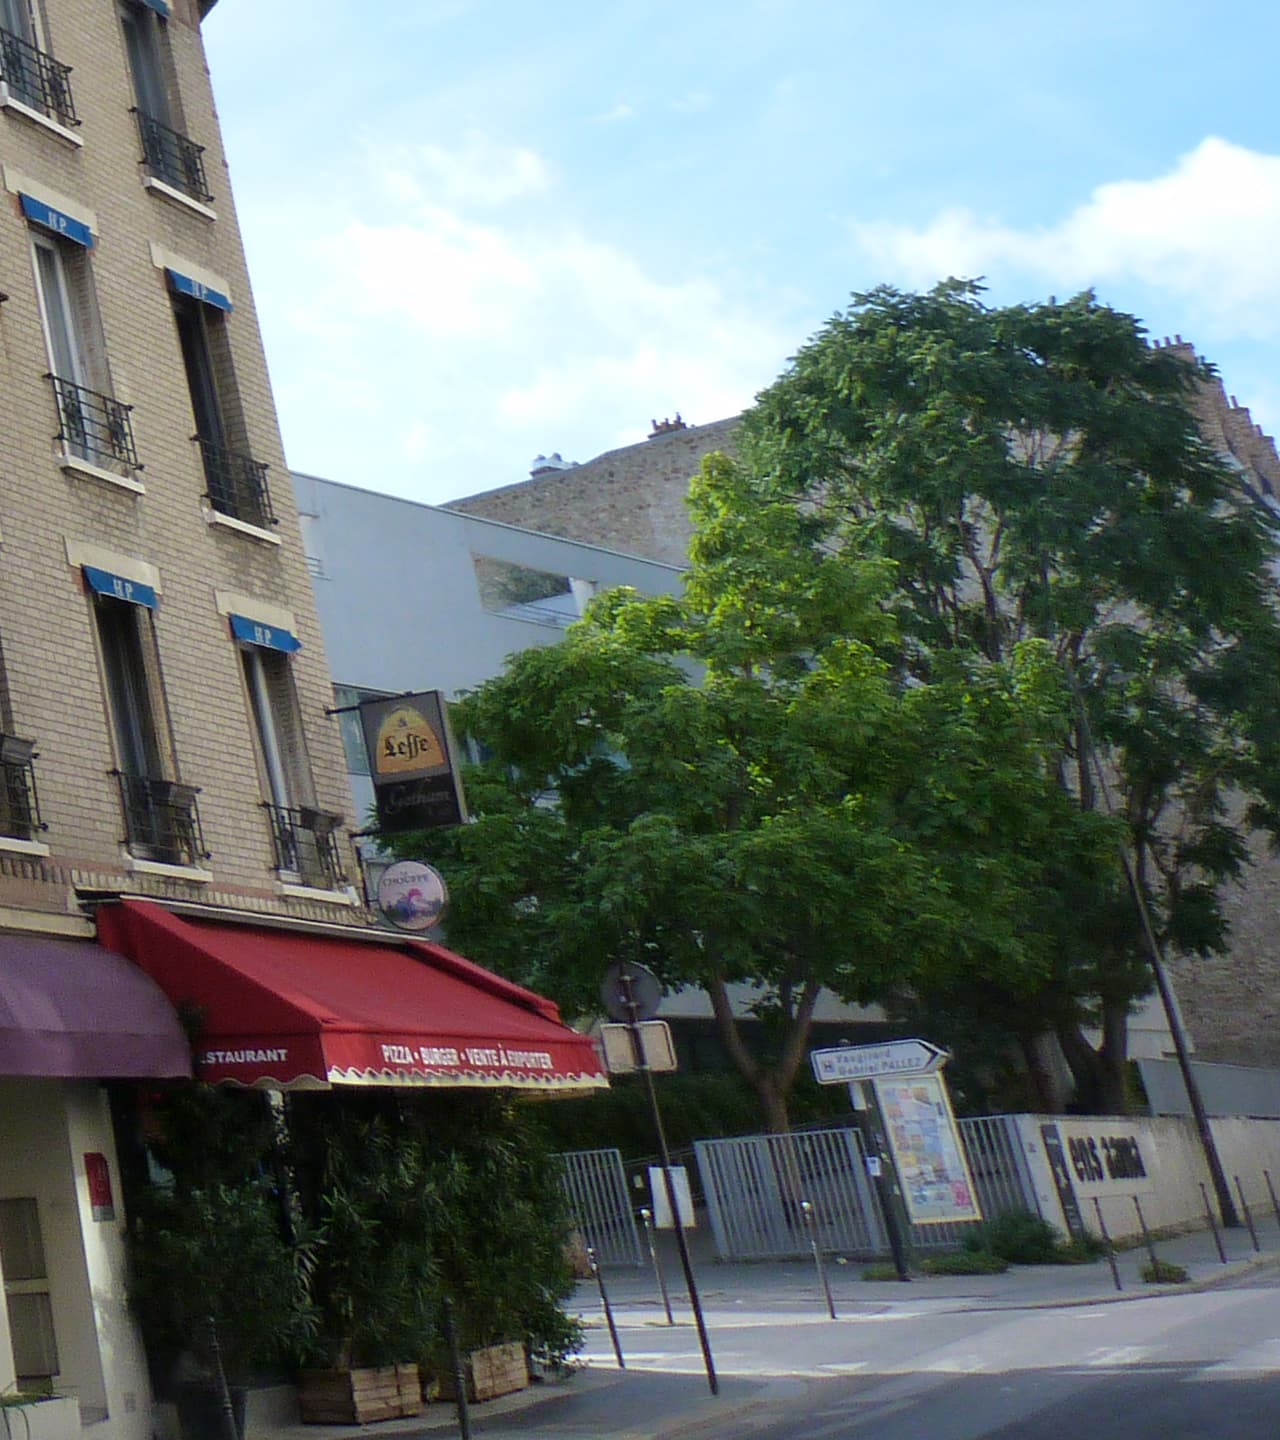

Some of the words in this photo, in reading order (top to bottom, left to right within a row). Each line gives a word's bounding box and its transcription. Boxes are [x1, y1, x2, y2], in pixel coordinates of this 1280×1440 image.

[384, 733, 429, 760] Leffe
[201, 1049, 288, 1064] STAURANT
[381, 1044, 414, 1065] PIZZA
[419, 1046, 461, 1066] BURGER
[465, 1047, 500, 1067] VENTE
[506, 1049, 554, 1070] EMPORTER
